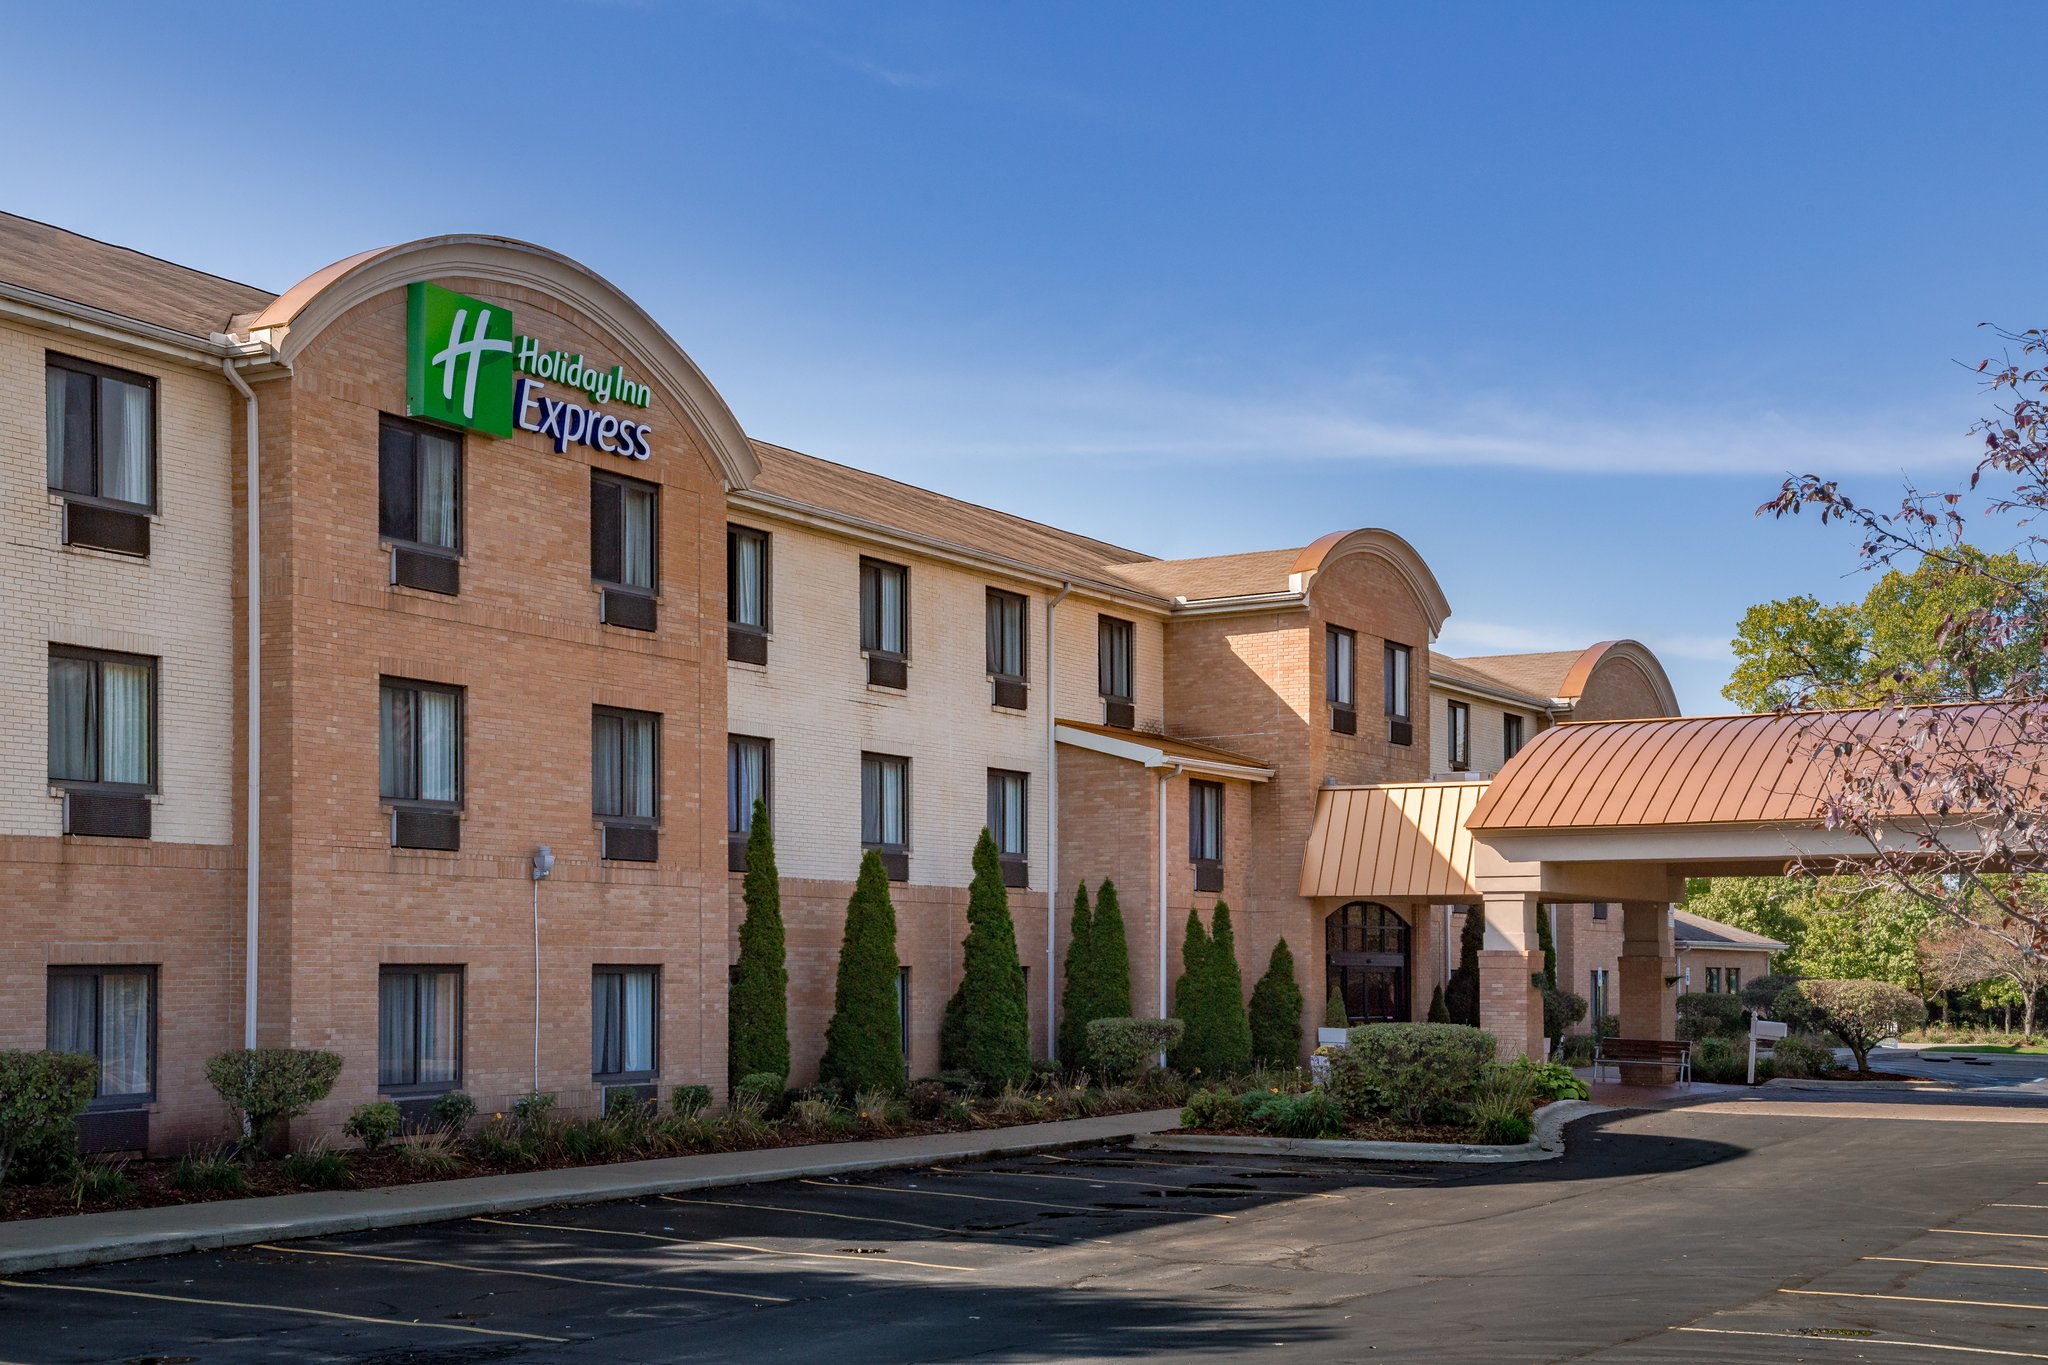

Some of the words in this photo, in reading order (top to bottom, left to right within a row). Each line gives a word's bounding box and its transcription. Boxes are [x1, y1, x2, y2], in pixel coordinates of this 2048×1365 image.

[432, 309, 512, 419] H
[518, 335, 612, 404] Holiday
[614, 366, 651, 408] Inn
[518, 378, 652, 460] Express
